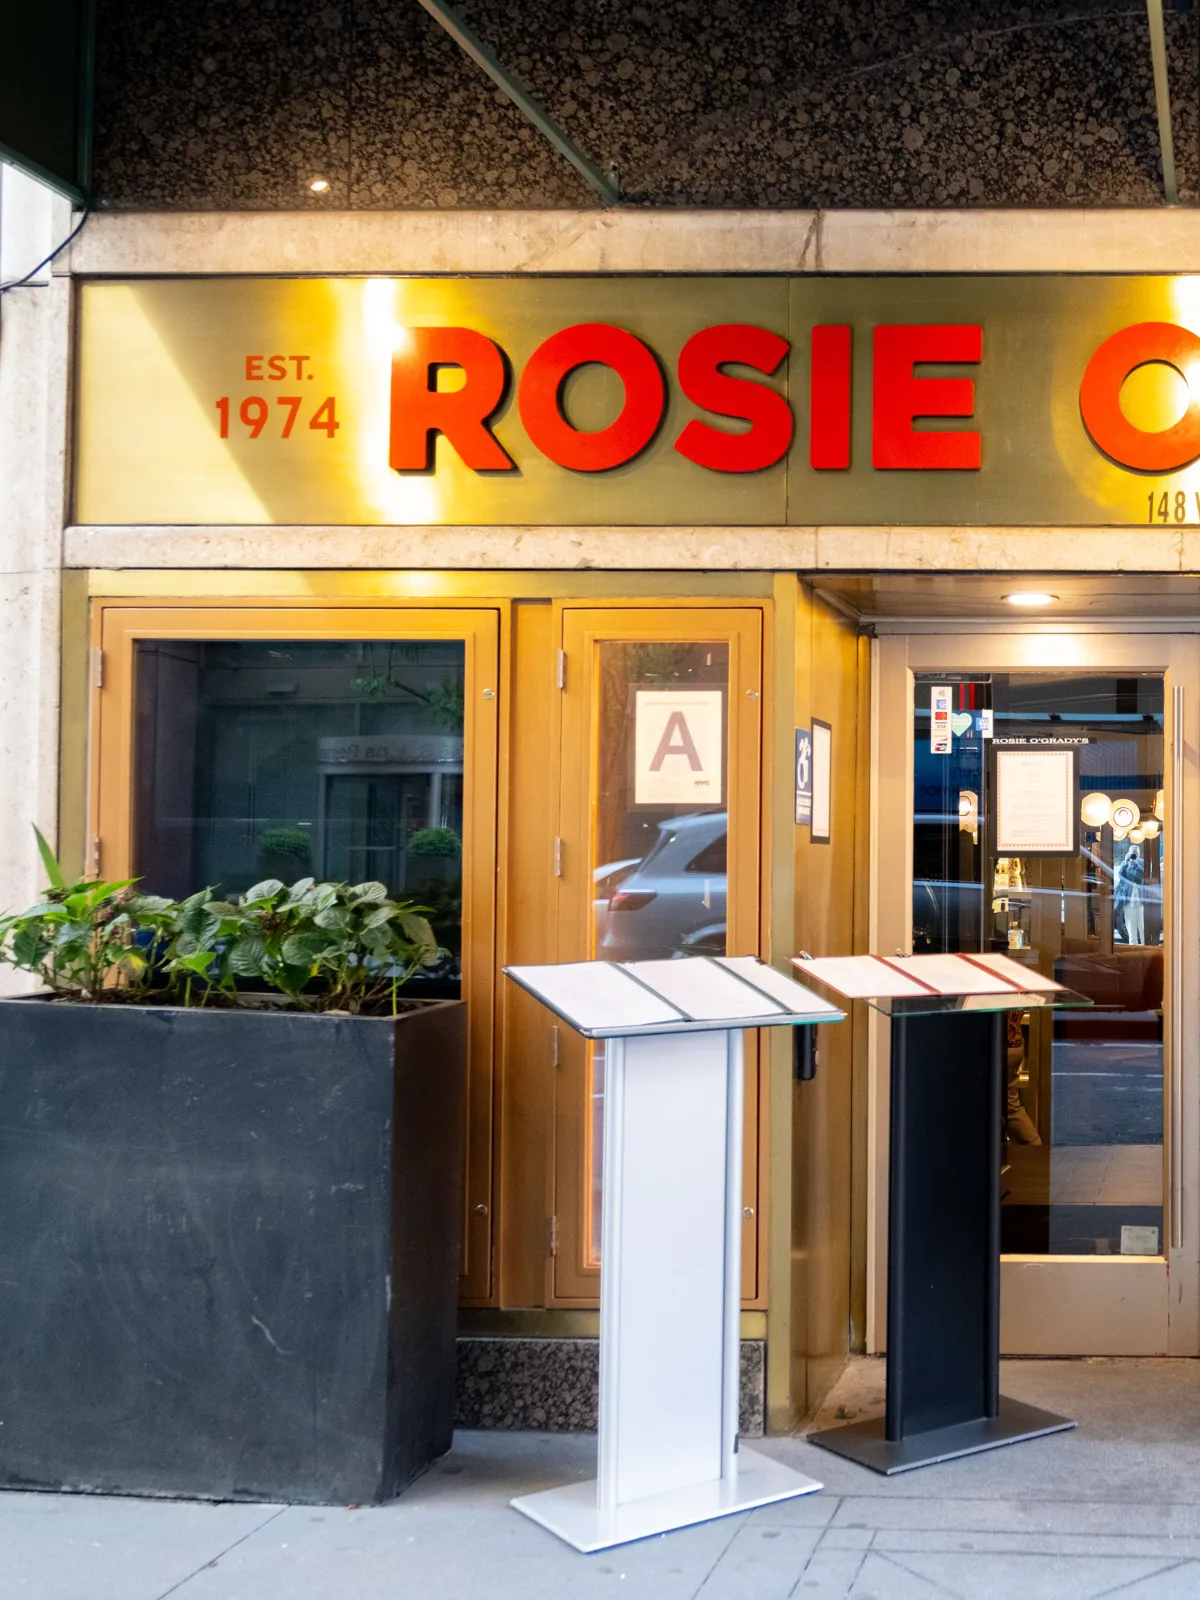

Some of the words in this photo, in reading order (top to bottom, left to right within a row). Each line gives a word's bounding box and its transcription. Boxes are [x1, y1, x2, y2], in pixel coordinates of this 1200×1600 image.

[245, 355, 314, 381] EST.
[388, 322, 984, 474] ROSIE
[215, 396, 341, 439] 1974
[1147, 490, 1186, 524] 148
[648, 710, 704, 772] A
[1029, 737, 1090, 745] O'GRADY'S
